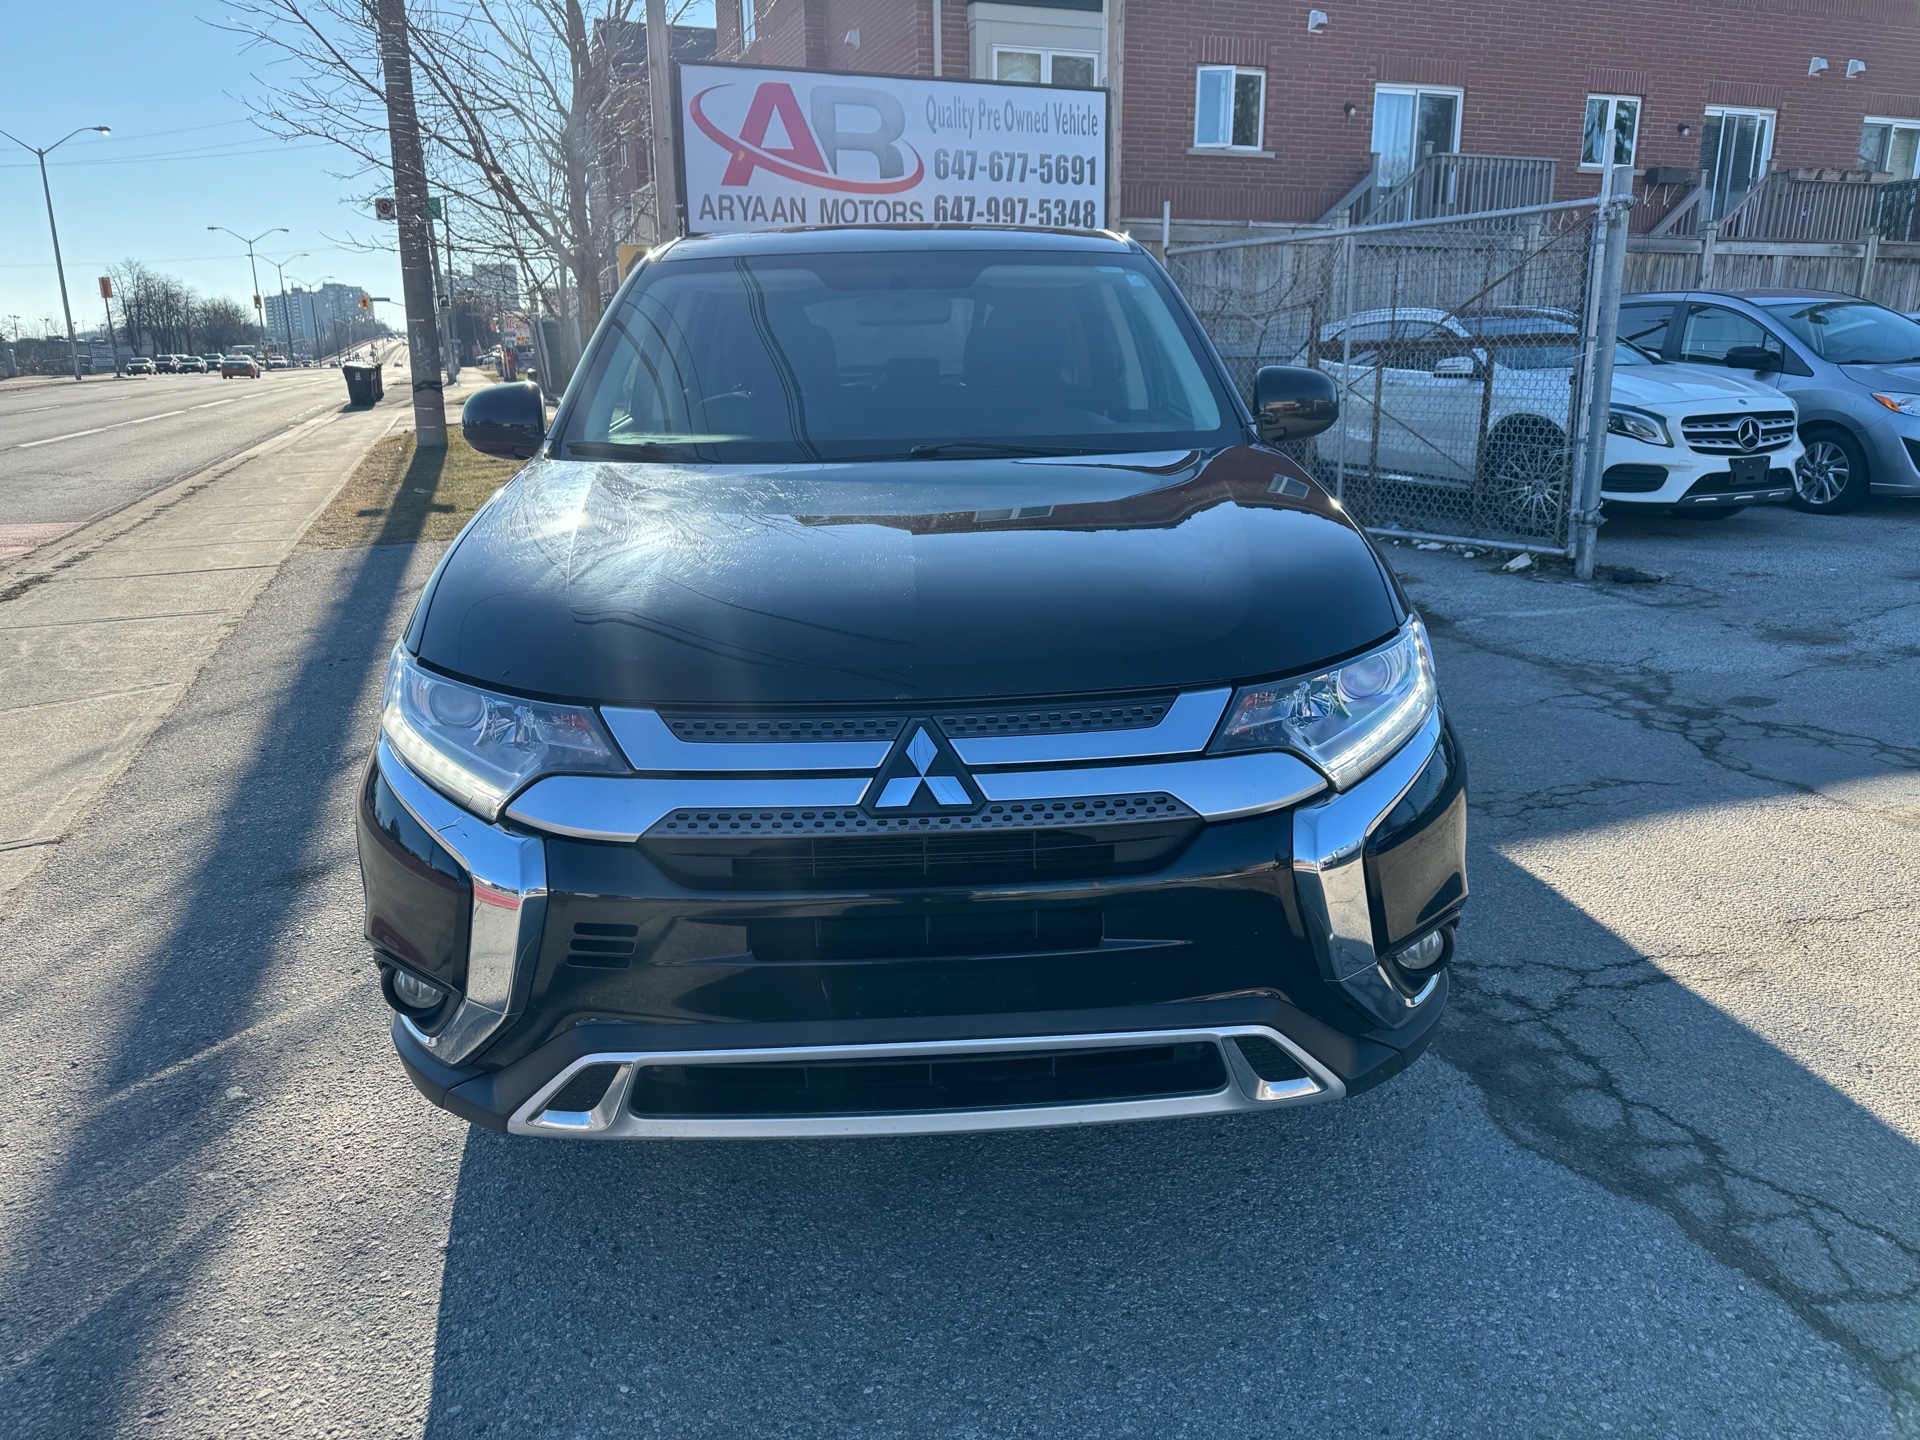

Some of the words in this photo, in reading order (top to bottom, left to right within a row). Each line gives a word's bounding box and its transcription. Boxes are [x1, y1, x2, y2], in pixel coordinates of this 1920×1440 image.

[925, 94, 975, 140] Quality
[978, 97, 1001, 132] Pre
[1003, 99, 1049, 134] Owned
[1053, 102, 1098, 137] Vehicle
[934, 148, 1097, 186] 647-677-5691
[698, 193, 807, 223] ARYAAN
[819, 198, 924, 225] MOTORS
[933, 194, 1097, 229] 647-997-5348
